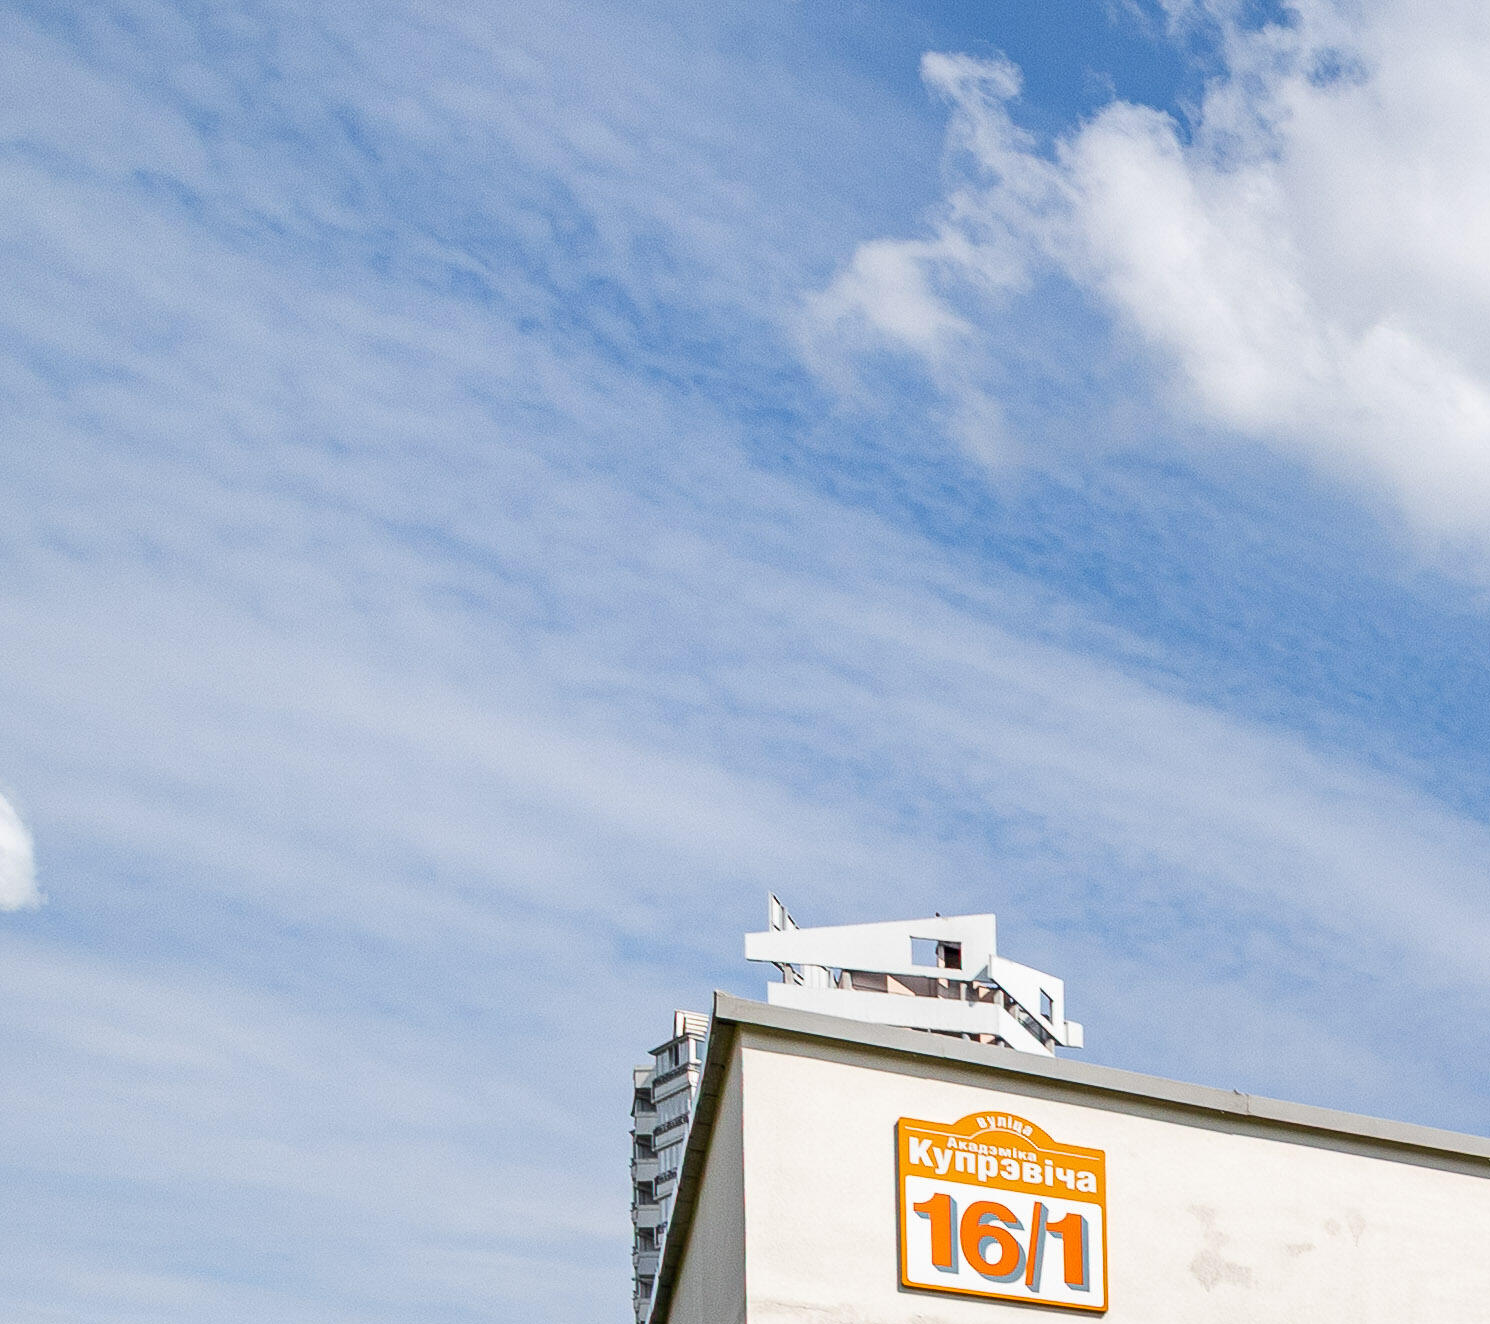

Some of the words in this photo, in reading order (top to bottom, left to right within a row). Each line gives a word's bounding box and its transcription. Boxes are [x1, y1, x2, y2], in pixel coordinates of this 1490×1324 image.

[976, 1115, 1033, 1137] вуліца
[908, 1136, 1097, 1193] Купрэвіча
[946, 1137, 1038, 1162] Акадэміка
[913, 1193, 1089, 1291] 16/1
